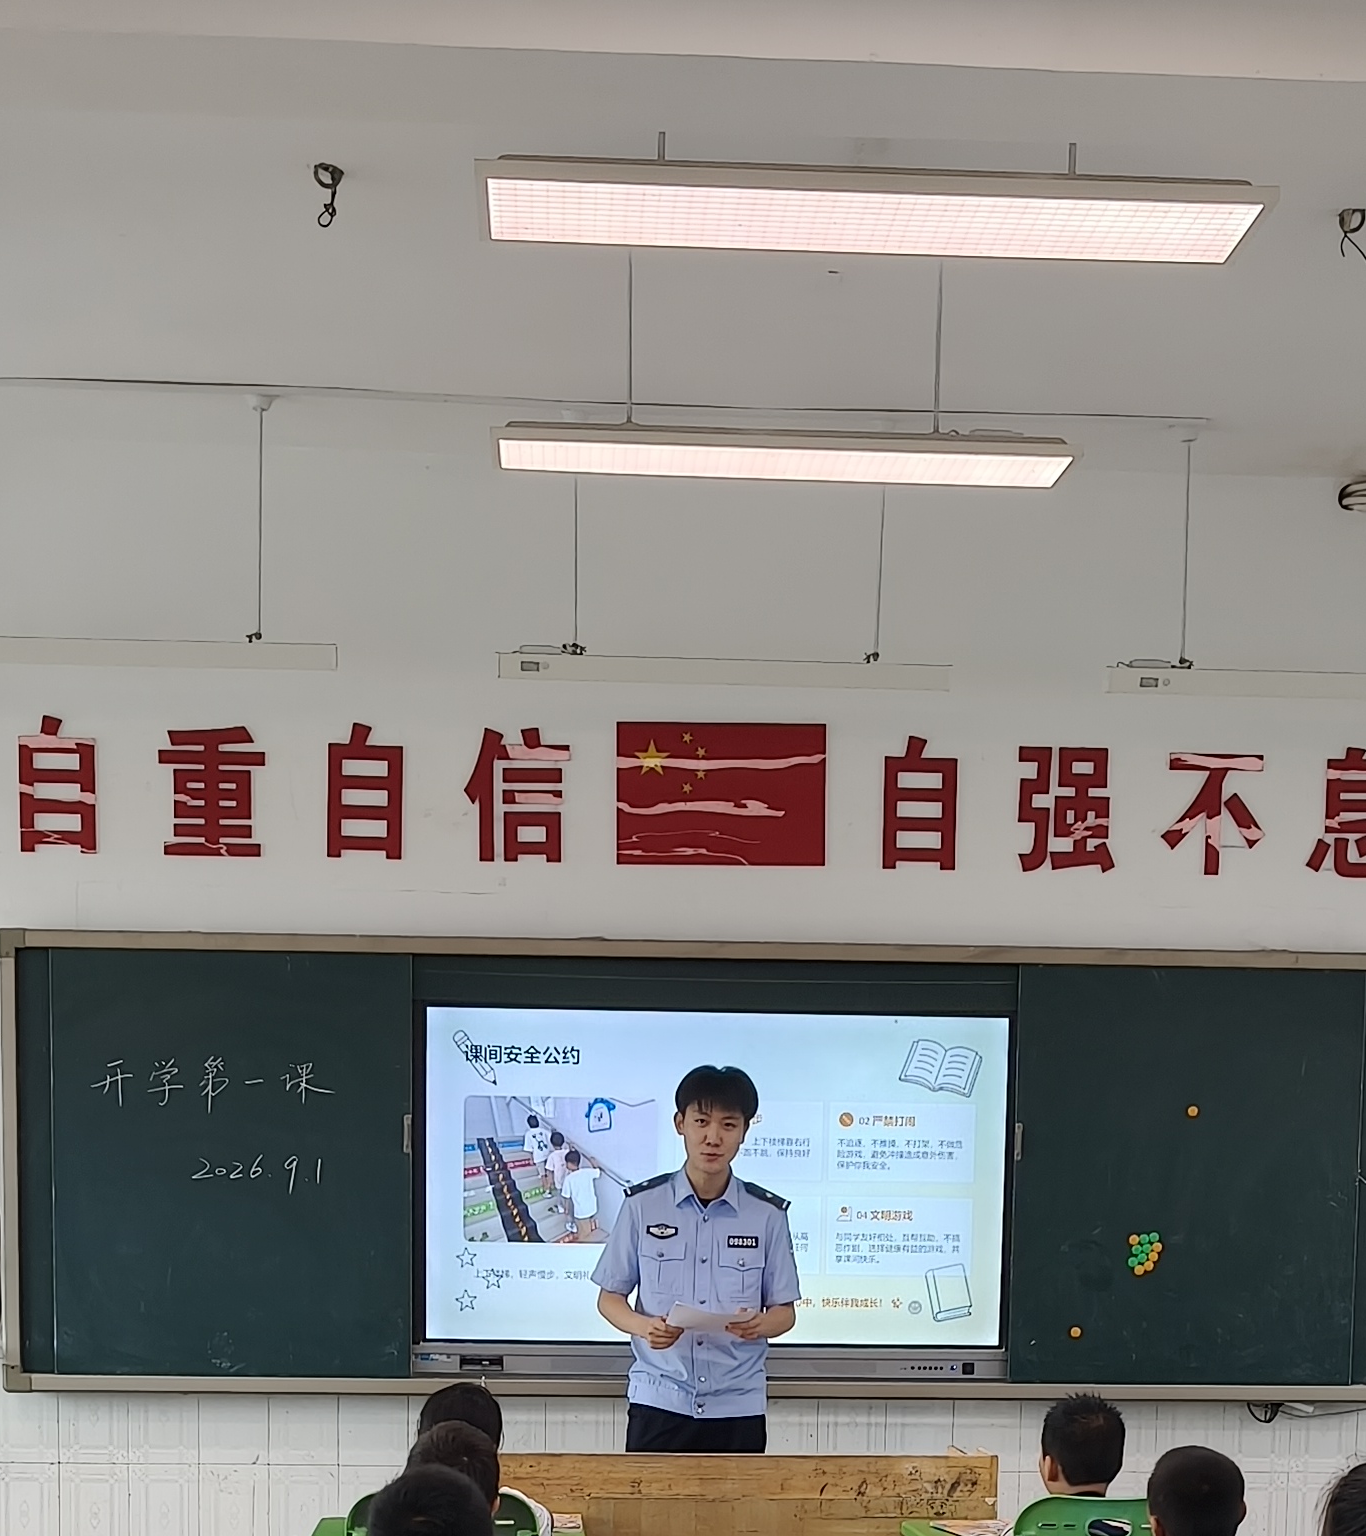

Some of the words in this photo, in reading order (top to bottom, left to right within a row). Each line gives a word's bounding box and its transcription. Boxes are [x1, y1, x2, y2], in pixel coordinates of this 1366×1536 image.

[19, 715, 571, 863] 自重自信
[464, 1045, 581, 1066] 课间安全公约
[90, 1055, 336, 1114] 开学第一课
[858, 1116, 870, 1126] 02
[191, 1153, 322, 1195] 2026.9.1
